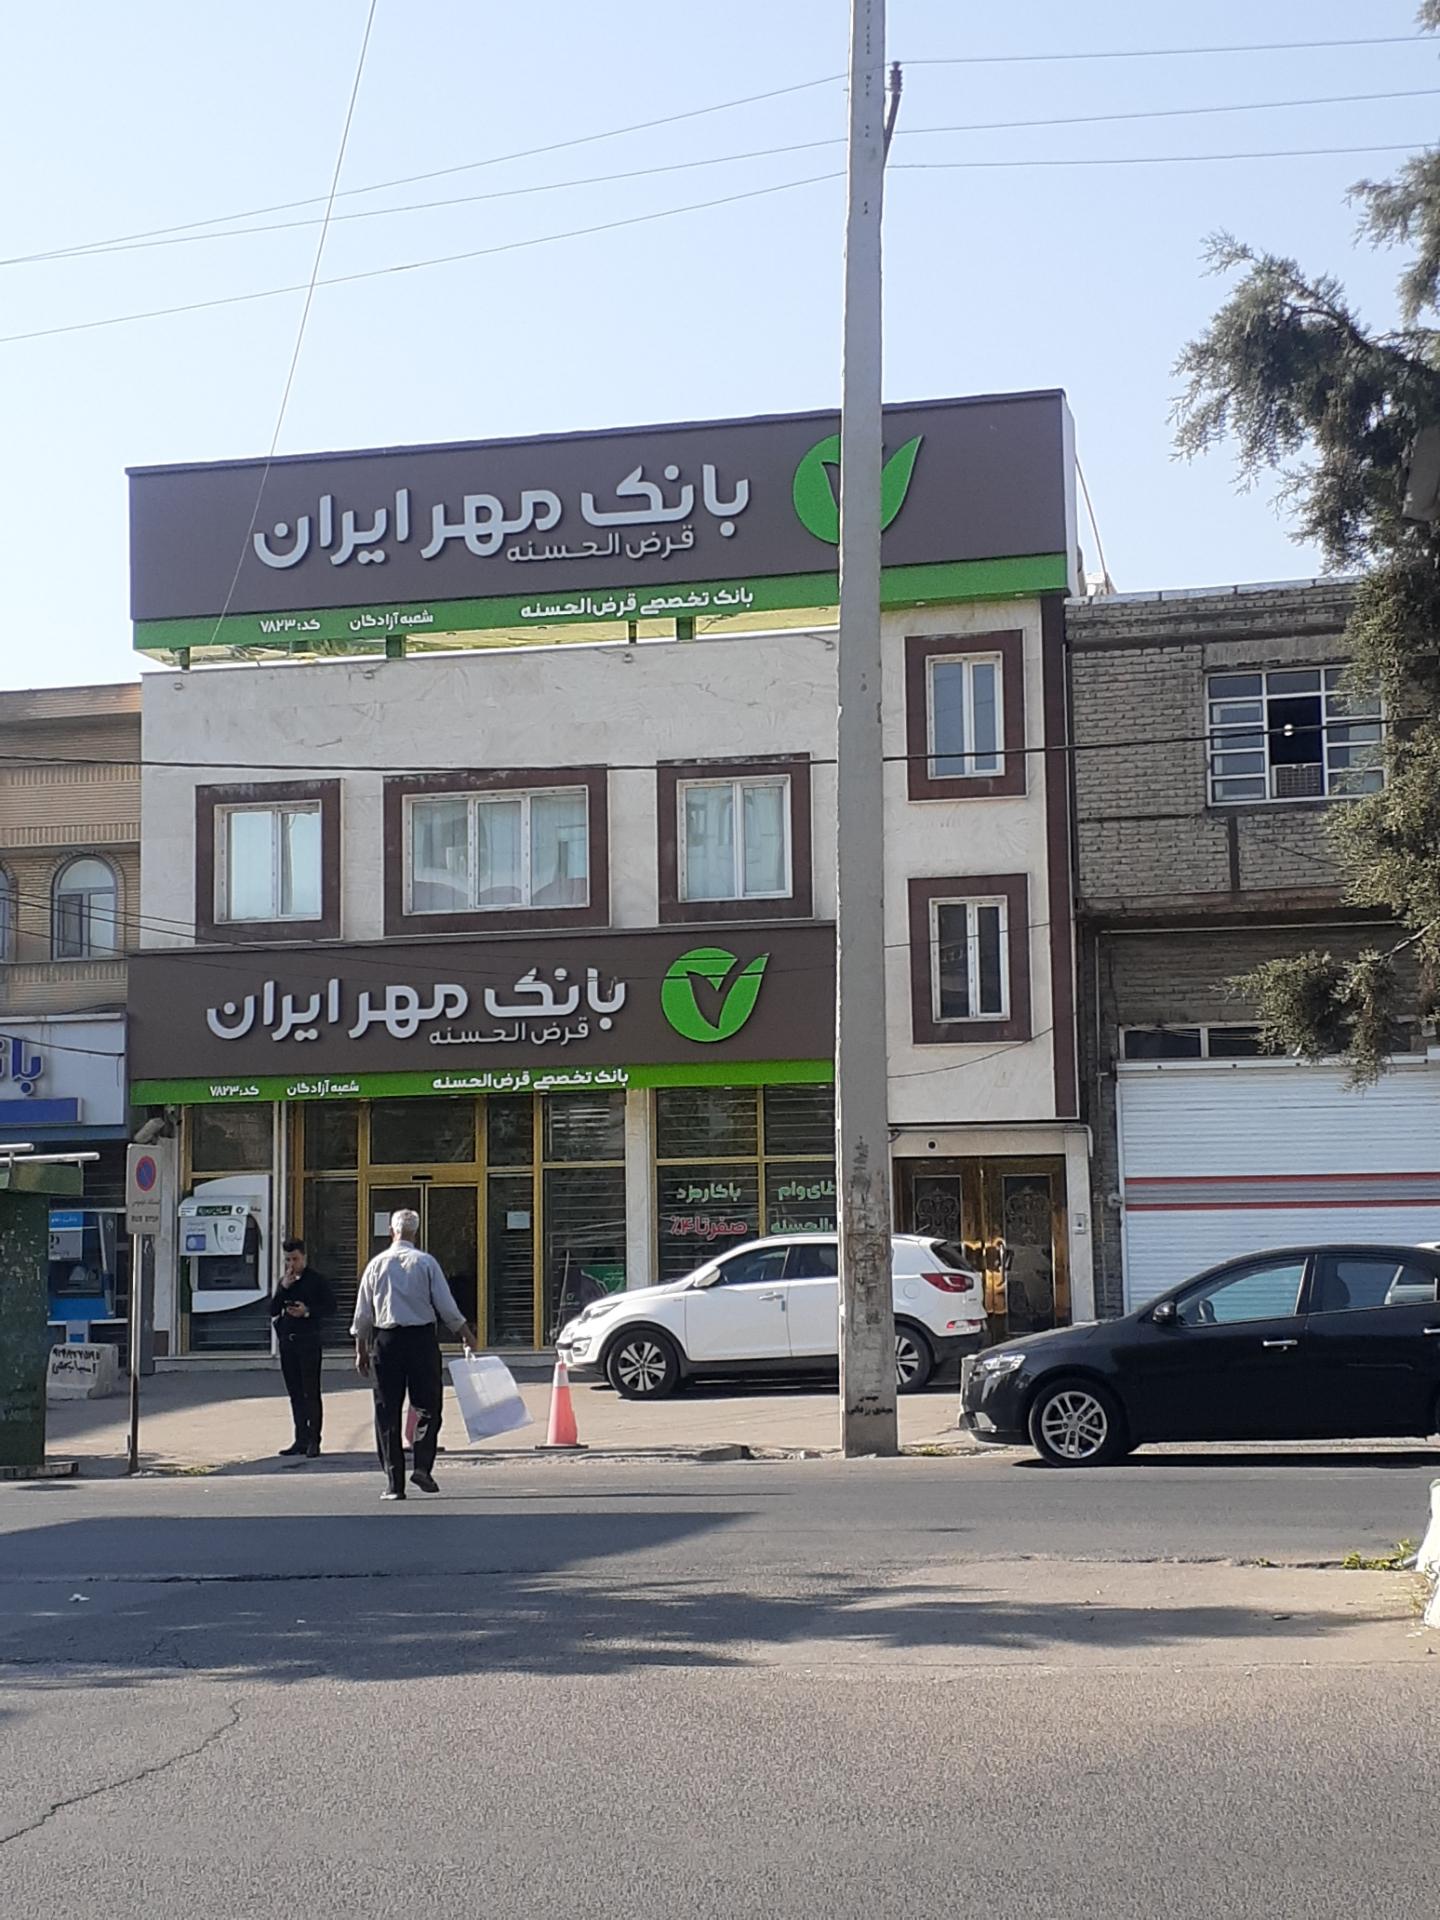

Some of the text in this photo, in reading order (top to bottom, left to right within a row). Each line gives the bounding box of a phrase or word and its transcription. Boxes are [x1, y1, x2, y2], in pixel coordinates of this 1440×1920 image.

[253, 463, 750, 569] بانک مهر ایران
[507, 524, 695, 562] قرض الحسنه
[640, 591, 710, 615] تخصصی
[713, 586, 753, 606] بانک
[350, 609, 434, 632] شعبه آزادگان
[206, 967, 626, 1042] بانک مهر ایران
[429, 1016, 589, 1046] قرض الحسنه
[286, 1079, 360, 1097] شعبه آزادگان
[533, 1071, 592, 1091] تخصصی
[594, 1068, 629, 1087] بانک
